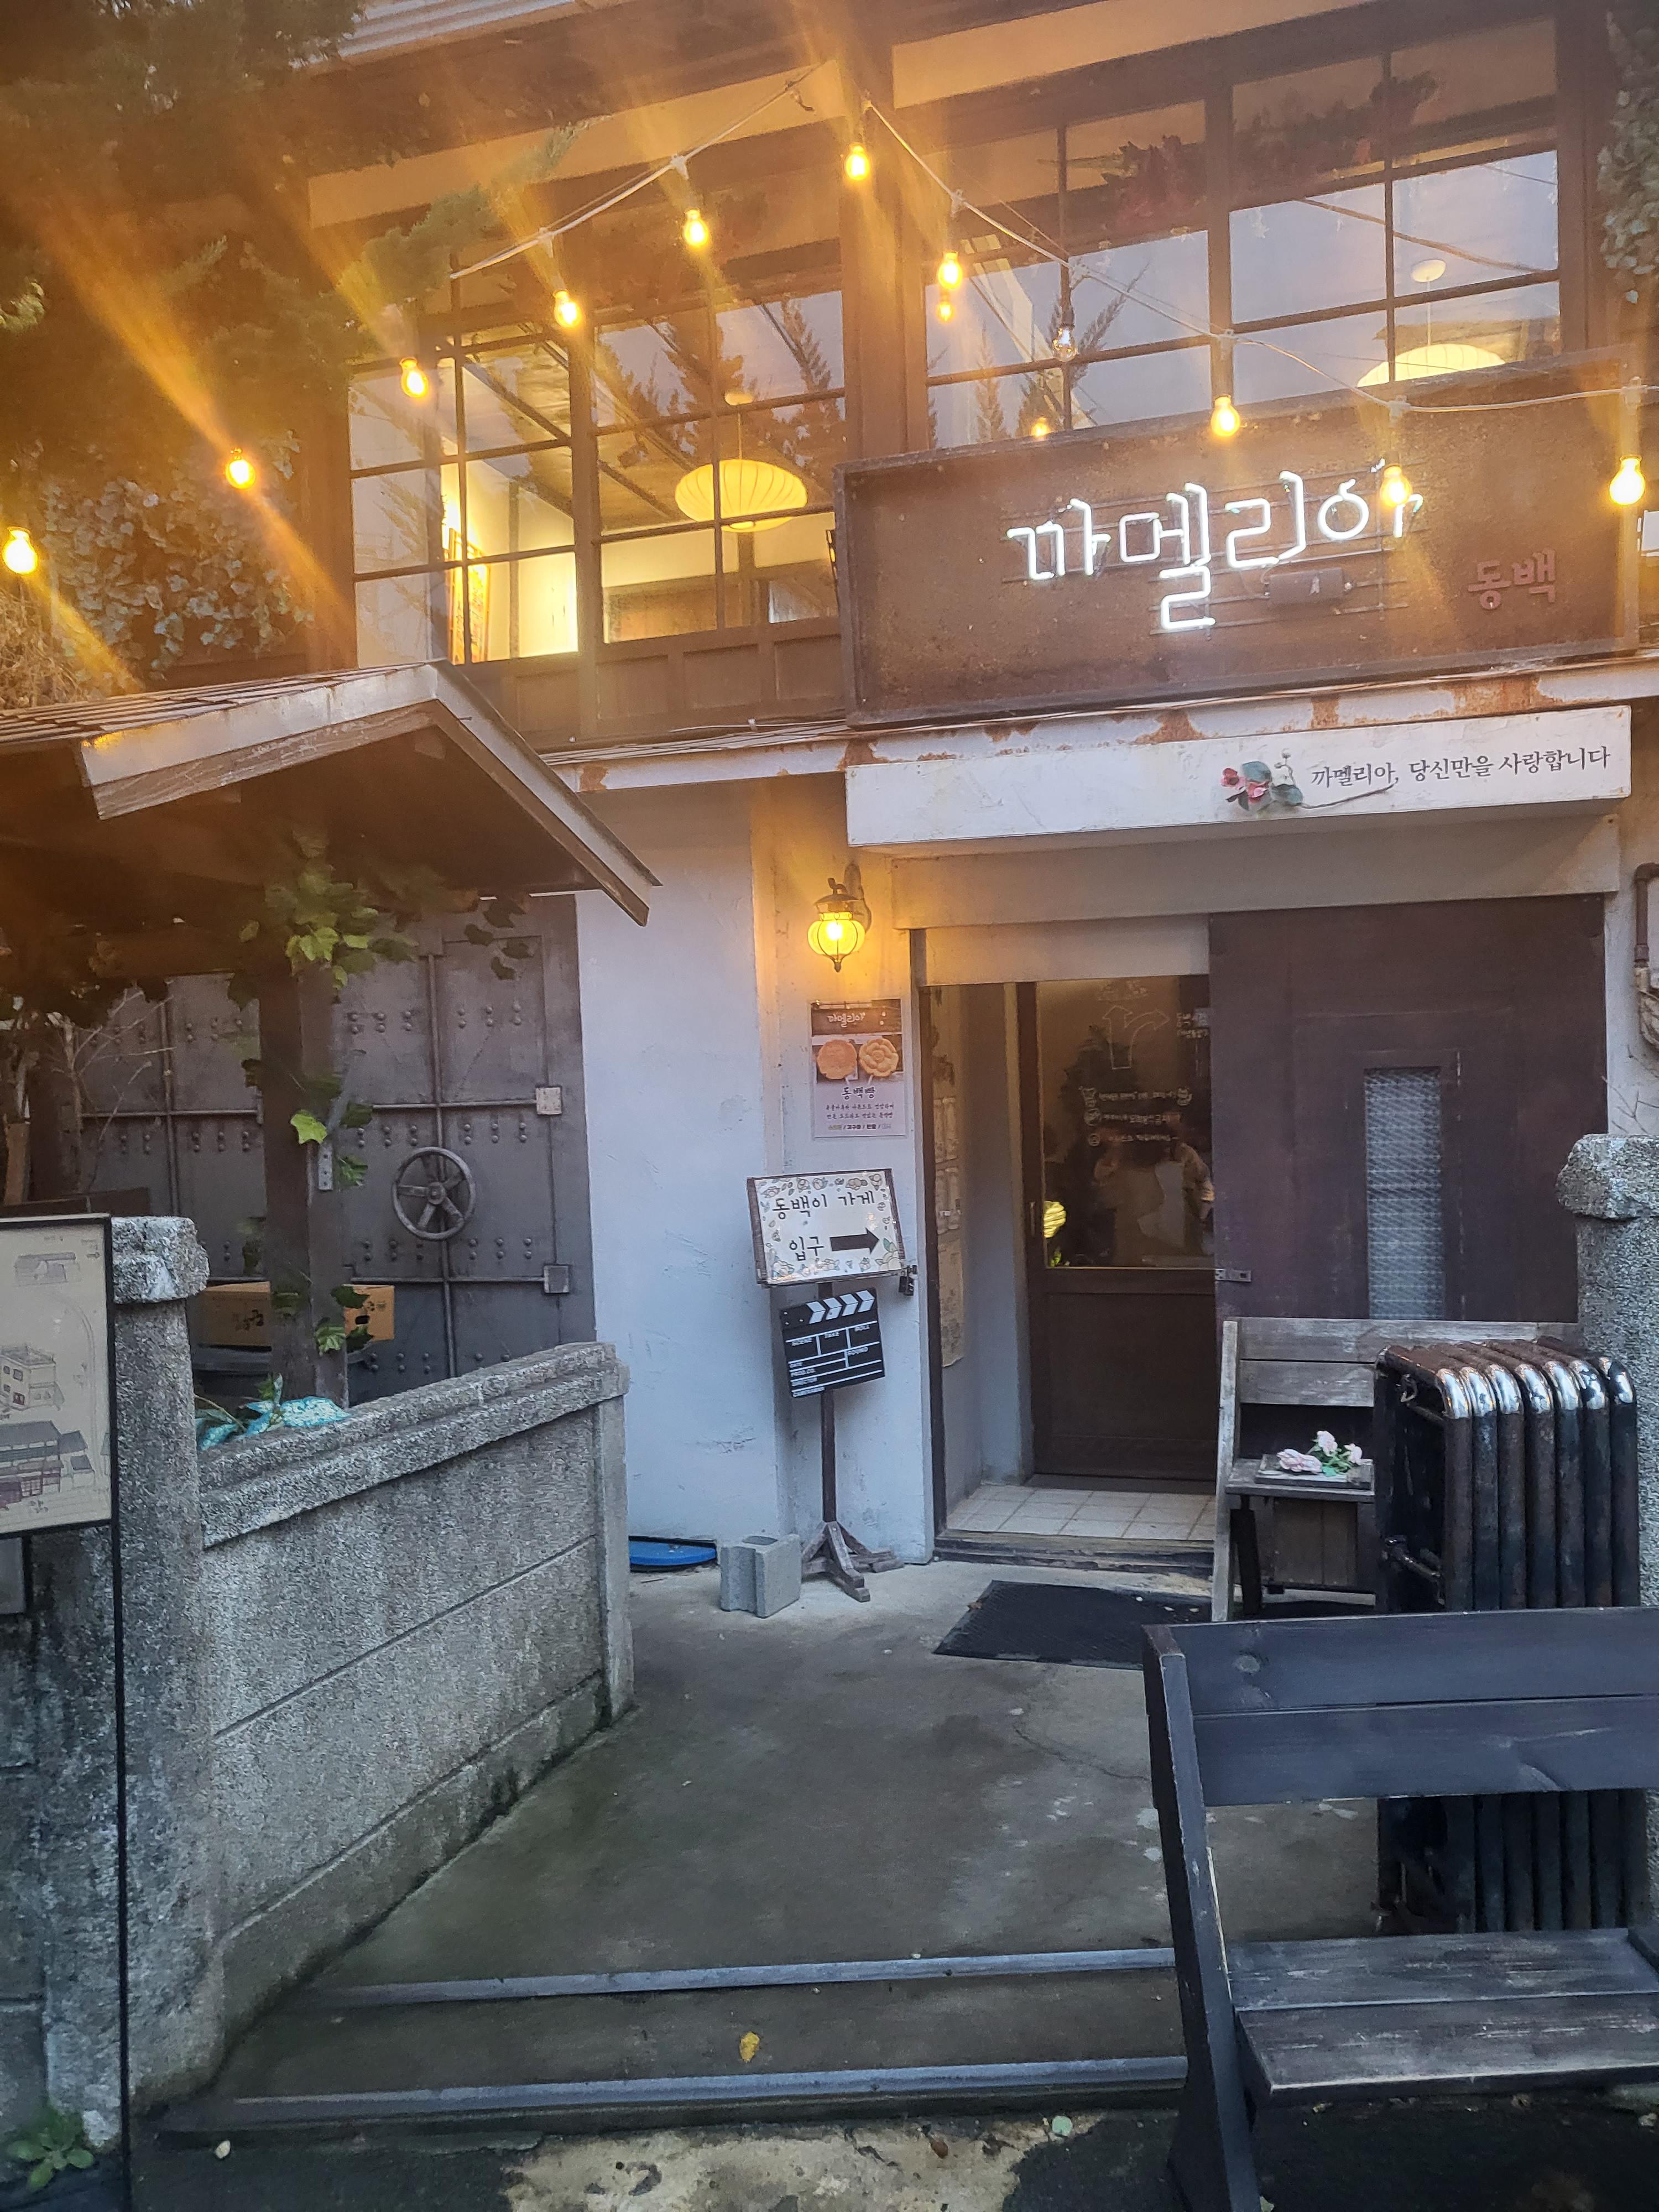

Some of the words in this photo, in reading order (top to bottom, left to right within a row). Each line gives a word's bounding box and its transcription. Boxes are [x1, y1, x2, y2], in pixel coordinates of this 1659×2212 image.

[1006, 469, 1423, 629] 까멜리아
[1468, 547, 1556, 609] 동백
[1408, 754, 1494, 781] 당신만을
[1499, 745, 1611, 775] 사랑합니다
[842, 1086, 877, 1100] 동백빵
[772, 1193, 828, 1220] 동백이
[838, 1191, 875, 1206] 가게
[789, 1236, 825, 1261] 입구
